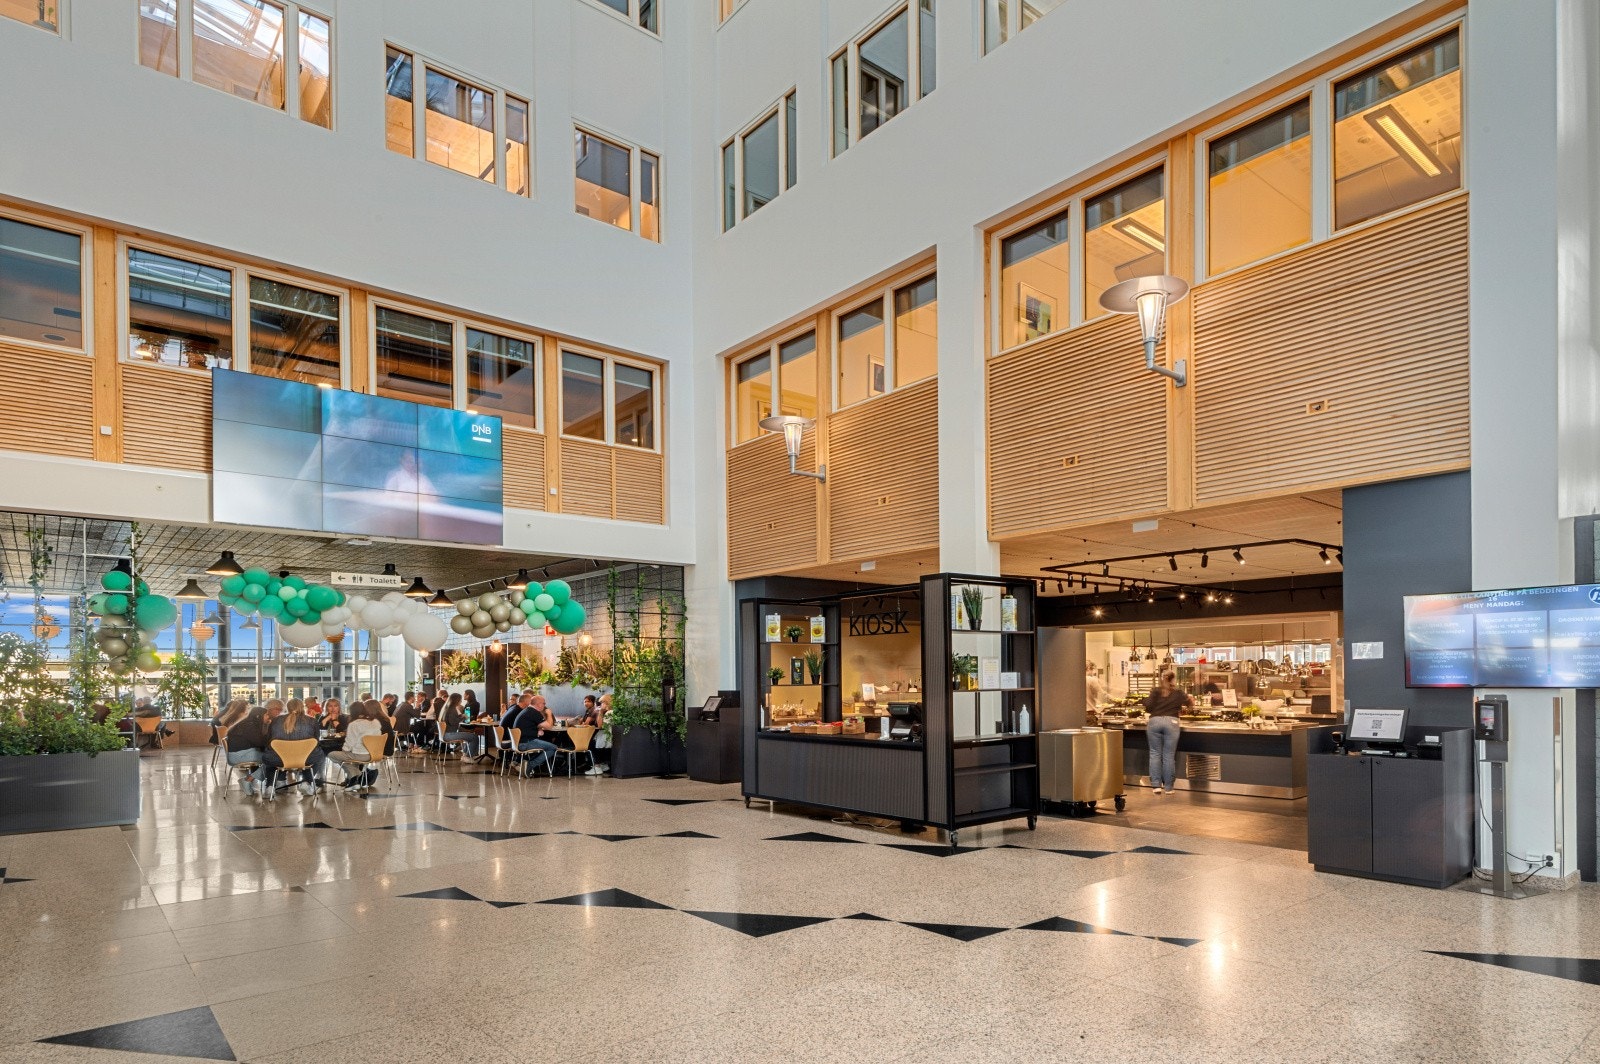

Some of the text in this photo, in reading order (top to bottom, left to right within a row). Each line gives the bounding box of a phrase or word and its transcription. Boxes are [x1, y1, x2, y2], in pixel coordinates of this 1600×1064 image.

[471, 423, 492, 436] DNB
[369, 576, 397, 585] Toalett
[1529, 586, 1579, 595] BEDDINGEN
[1486, 600, 1524, 608] MANDAG:
[849, 611, 910, 637] KIOSK
